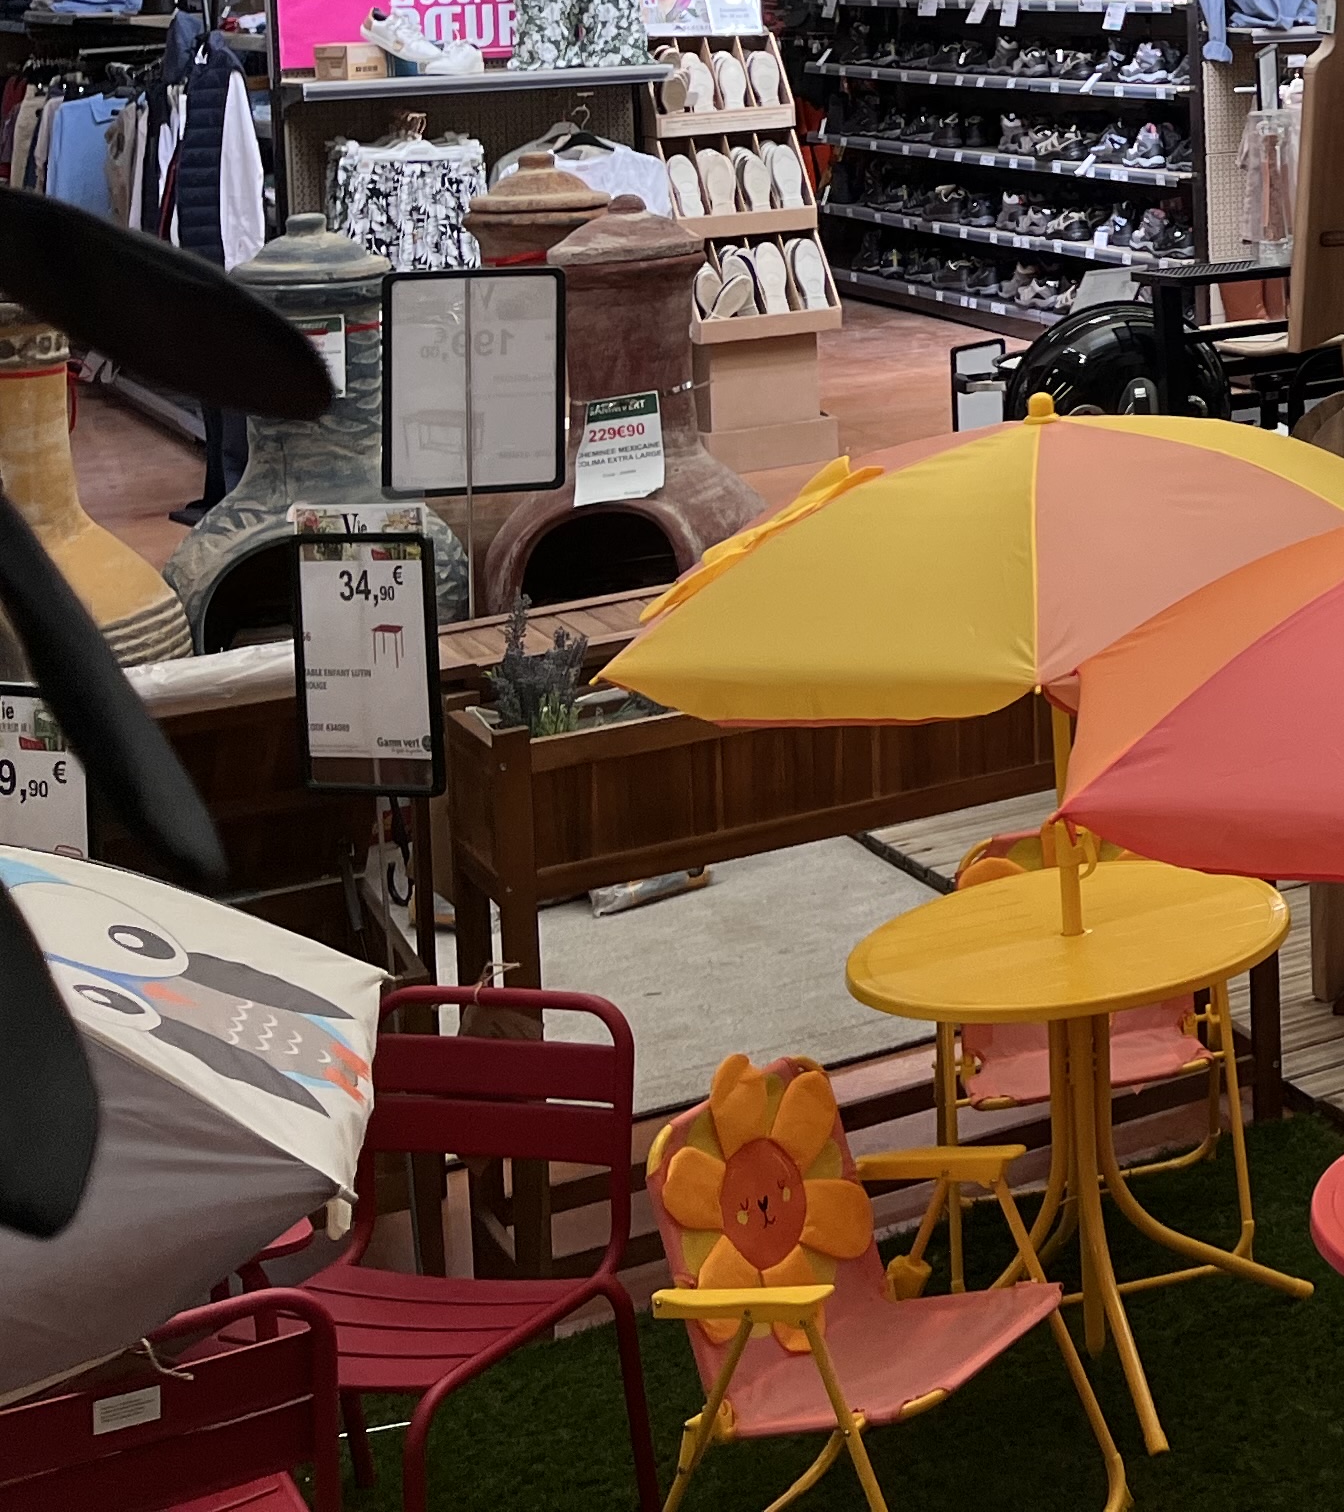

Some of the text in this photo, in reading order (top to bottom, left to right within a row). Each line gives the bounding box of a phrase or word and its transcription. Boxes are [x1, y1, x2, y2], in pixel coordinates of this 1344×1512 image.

[588, 423, 646, 443] 229€90
[607, 453, 634, 464] EXTRA
[376, 736, 420, 748] Gamm vert
